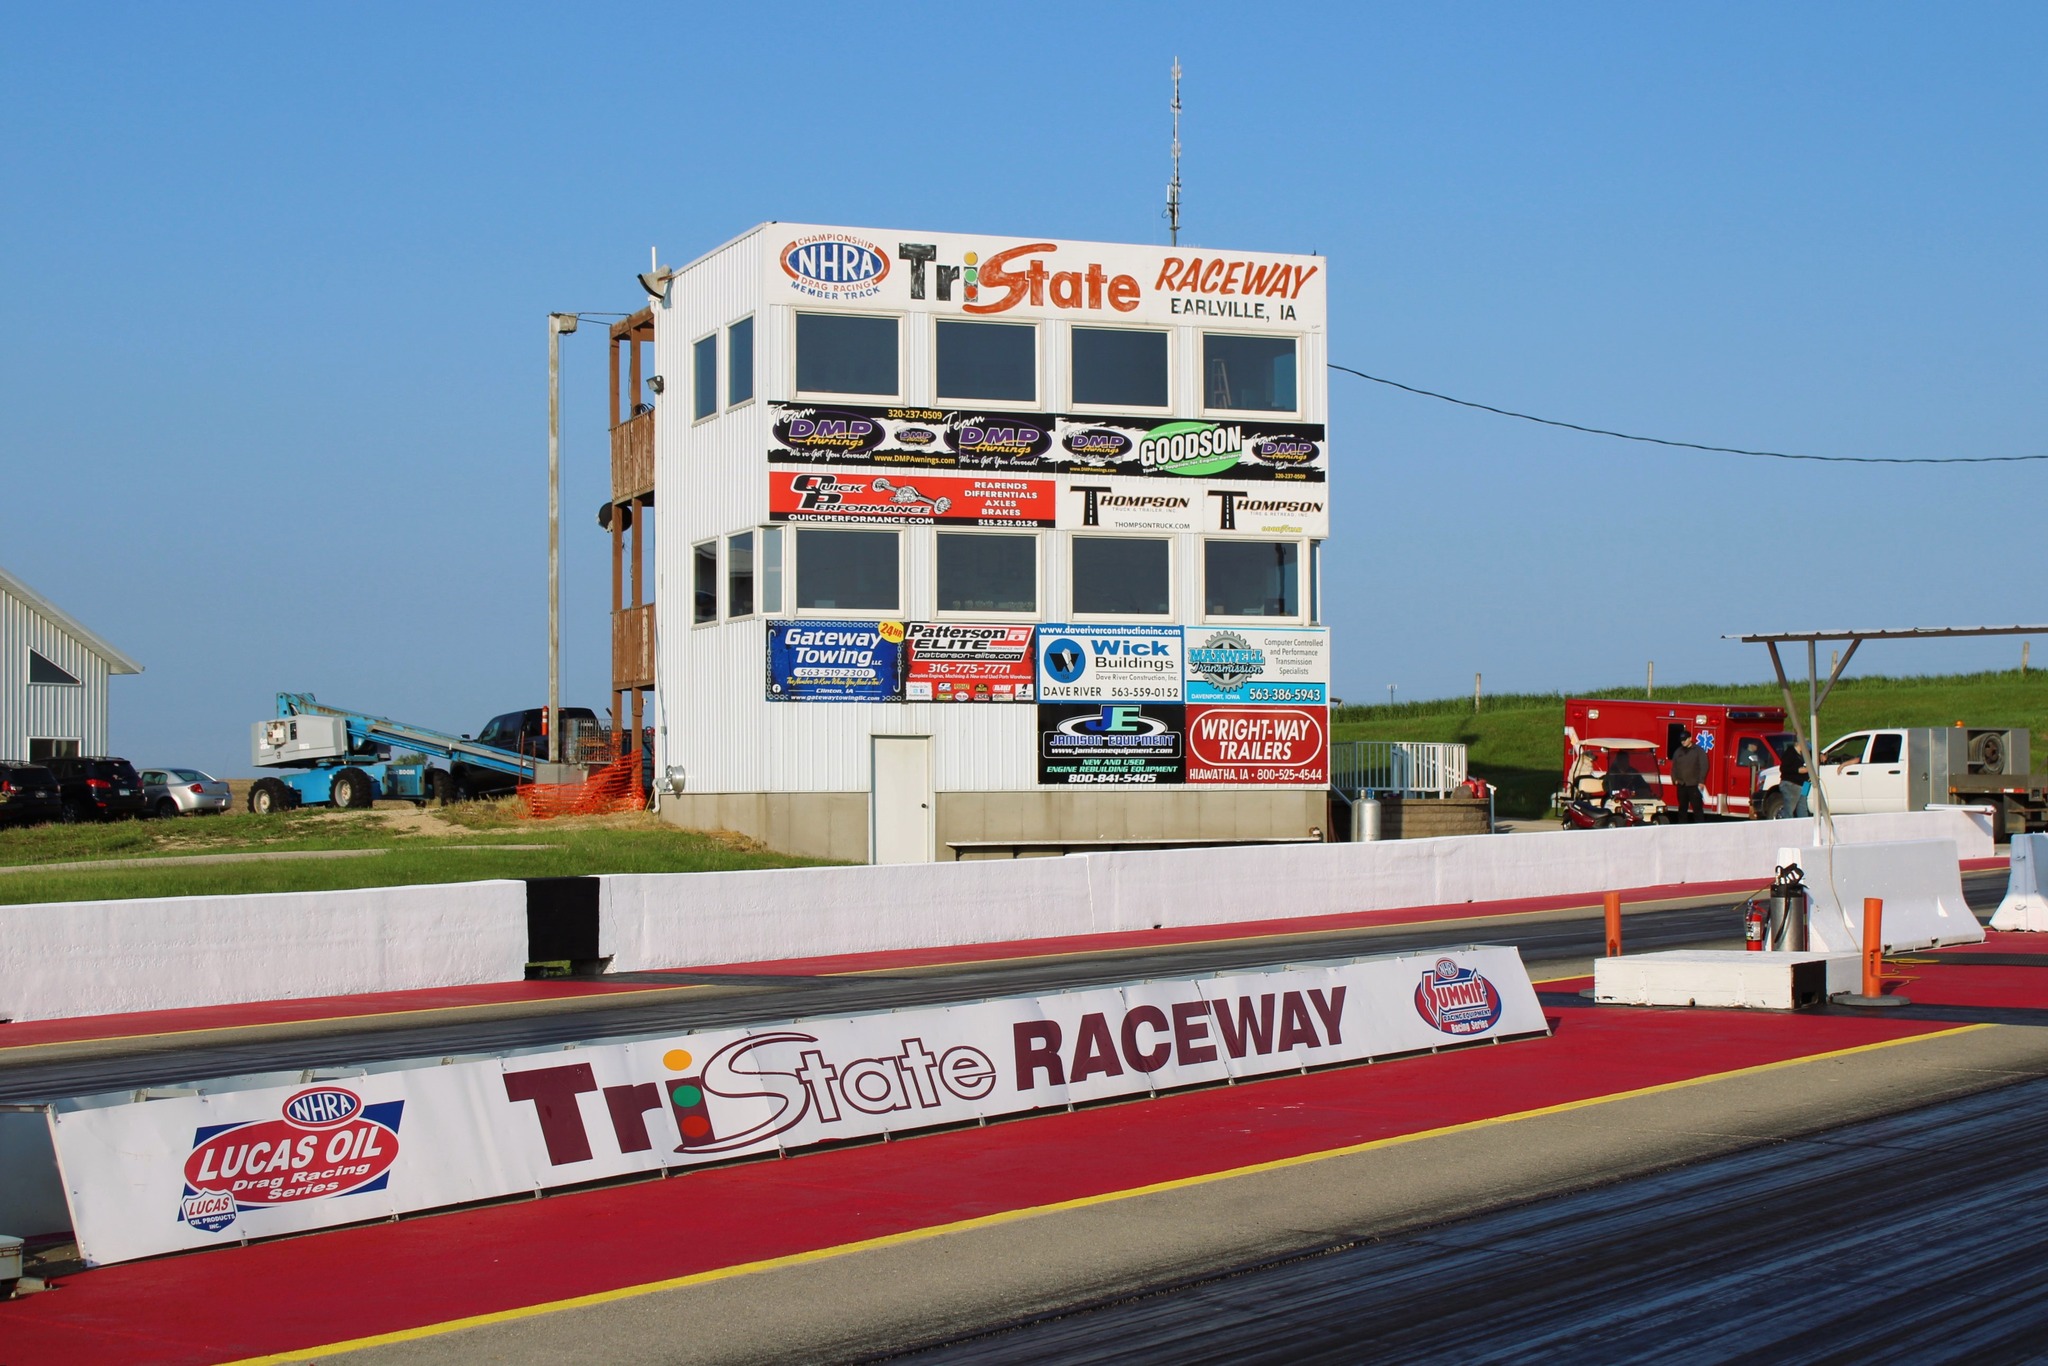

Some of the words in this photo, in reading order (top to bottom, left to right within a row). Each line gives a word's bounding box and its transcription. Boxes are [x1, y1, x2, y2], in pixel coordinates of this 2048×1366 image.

[798, 234, 874, 249] CHAMPIONSHIP
[798, 245, 874, 281] NHRA
[801, 277, 828, 291] DRAG
[834, 281, 871, 292] RACING
[1155, 257, 1318, 299] RACEWAY
[791, 281, 838, 300] MEMBER
[844, 286, 880, 300] TRACK
[1171, 298, 1270, 323] EARLVILLE,
[1280, 305, 1297, 321] IA
[771, 404, 816, 426] Team
[888, 409, 942, 419] 320-237-0509
[788, 419, 872, 439] DMP
[942, 411, 985, 433] Team
[797, 434, 864, 450] Awnings
[900, 431, 932, 439] DMP
[959, 427, 1039, 446] DMP
[1072, 435, 1124, 448] DMP
[1251, 432, 1277, 447] Team
[966, 441, 1031, 457] Awnings
[1081, 445, 1119, 455] Awnings
[1141, 426, 1241, 467] GOODSON
[1261, 443, 1312, 455] DMP
[874, 455, 955, 465] www.DMPAwnings.com
[1270, 452, 1307, 462] Awnings
[1165, 462, 1189, 470] Supplies
[974, 481, 1027, 490] REARENDS
[964, 490, 1038, 499] DIFFERENTIALS
[801, 492, 929, 513] PERFORMANCE
[985, 499, 1017, 507] AXLES
[1070, 485, 1190, 526] THOMPSON
[981, 508, 1021, 516] BRAKES
[1207, 490, 1324, 530] THOMPSON
[788, 514, 935, 525] QUICKPERFORMANCE.COM
[978, 519, 1038, 527] 515.232.0126
[908, 624, 1006, 639] Patterson
[1040, 626, 1181, 635] www.daveriverconstructioninc.com
[785, 628, 882, 649] Gateway
[914, 639, 990, 650] ELITE
[1264, 638, 1293, 647] Computer
[1294, 639, 1324, 647] Controlled
[1091, 640, 1170, 656] Wick
[796, 647, 873, 667] Towing
[917, 652, 1020, 660] patterson-elite.com
[1189, 649, 1265, 664] MAXWELL
[1276, 657, 1312, 665] Transmission
[928, 663, 1011, 674] 316-775-7771
[1095, 656, 1174, 672] Buildings
[1191, 662, 1263, 674] Transmission
[1129, 674, 1167, 682] Construction,
[1279, 667, 1309, 676] Specialists
[1043, 686, 1071, 696] DAVE
[1074, 687, 1102, 696] RIVER
[1112, 687, 1179, 697] 563-559-0152
[1249, 688, 1321, 701] 563-386-5943
[1085, 707, 1139, 731] JE
[1201, 719, 1311, 741] WRIGHT-WAY
[1050, 735, 1103, 746] JAMISON
[1108, 735, 1175, 746] EQUIPMENT
[1051, 747, 1173, 755] www.jamisonequipment.com
[1220, 741, 1292, 760] TRAILERS
[1068, 773, 1157, 783] 800-841-5405
[1189, 768, 1238, 780] HIAWATHA,
[1240, 769, 1249, 780] IA
[1257, 769, 1322, 780] 800-525-4544
[1443, 1014, 1462, 1022] RACING
[1463, 1009, 1491, 1020] EQUIPMENT
[1450, 1022, 1470, 1033] Racing
[1471, 1019, 1489, 1030] Series
[1014, 985, 1347, 1091] RACEWAY
[293, 1093, 352, 1121] NHRA
[197, 1135, 318, 1182] LUCAS
[325, 1126, 382, 1164] OIL
[232, 1176, 284, 1192] Drag
[291, 1163, 371, 1184] Racing
[268, 1180, 339, 1200] Series
[189, 1197, 230, 1216] LUCAS
[203, 1213, 235, 1224] PRODUCTS
